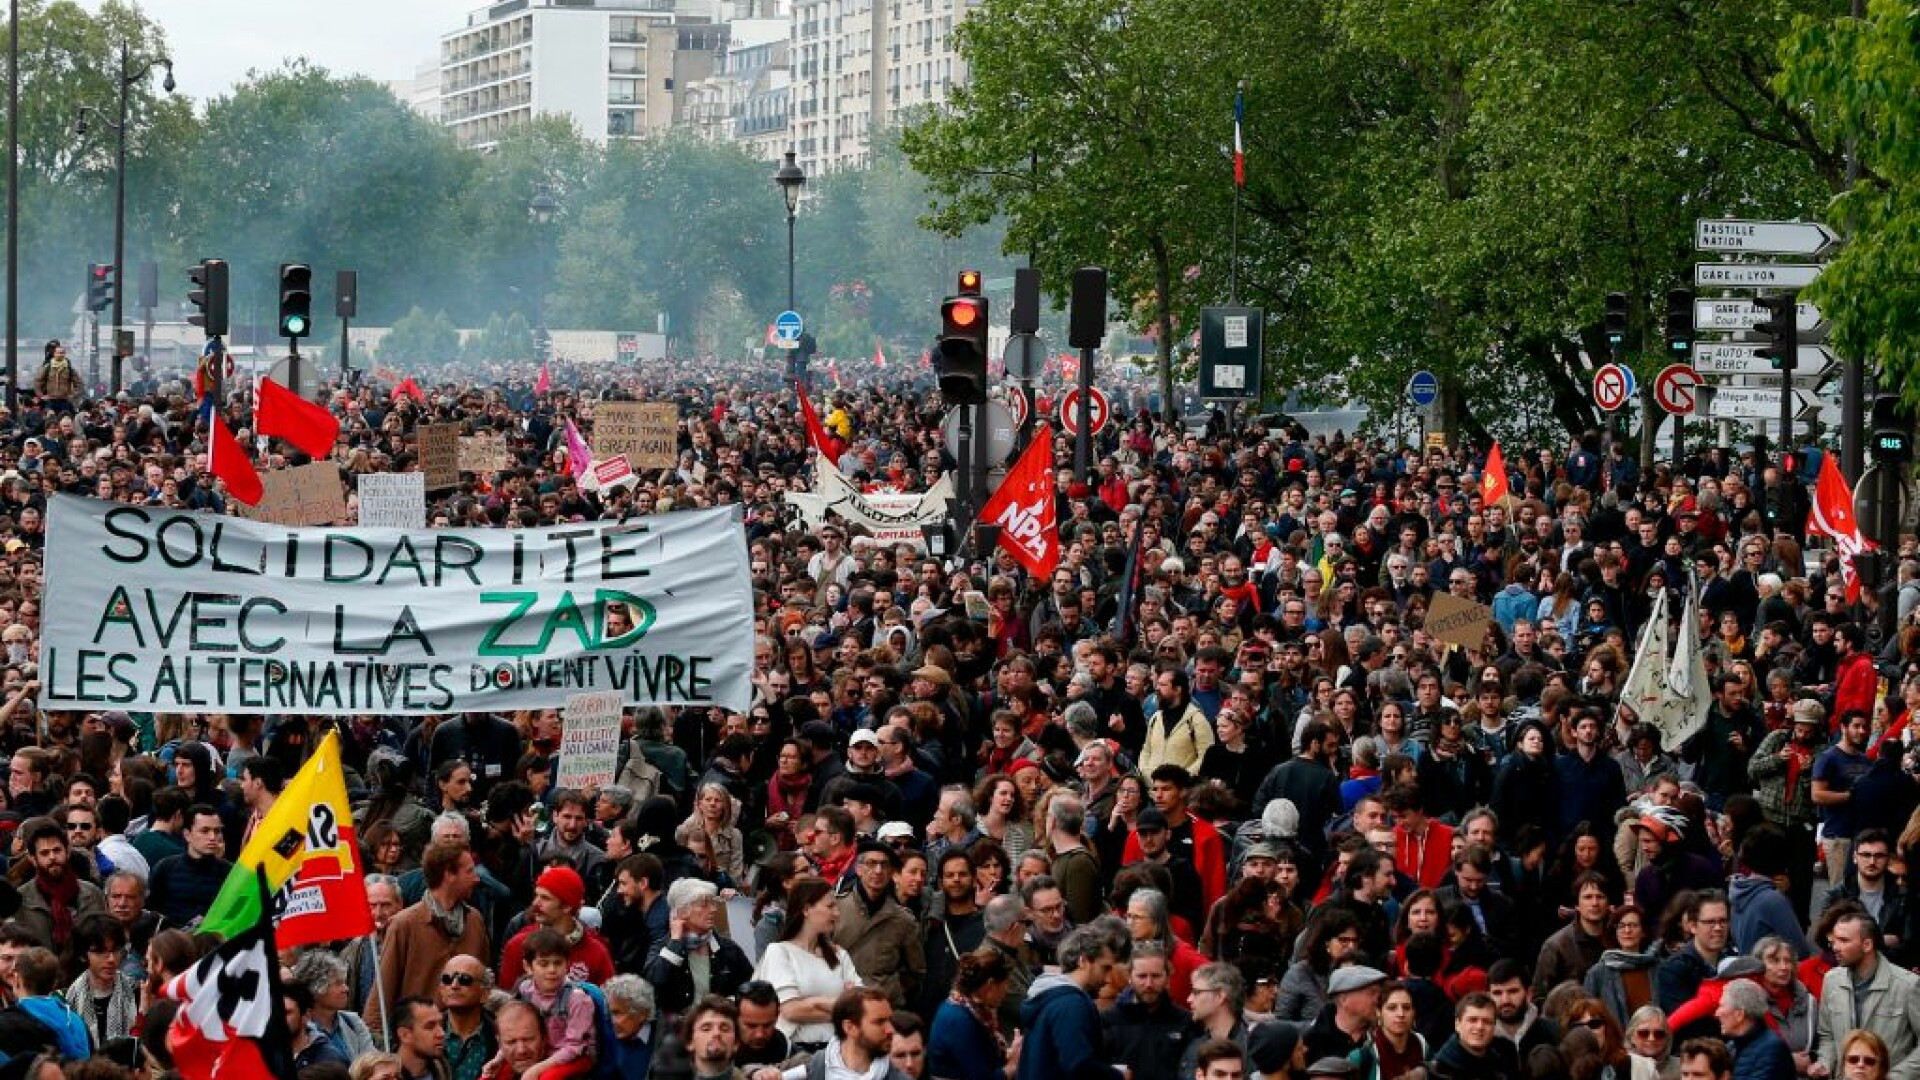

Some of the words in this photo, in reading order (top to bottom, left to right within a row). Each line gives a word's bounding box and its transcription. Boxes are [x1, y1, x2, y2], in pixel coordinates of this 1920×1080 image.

[1703, 224, 1755, 236] BASTILLE
[1703, 237, 1743, 246] NATION
[1702, 270, 1731, 280] GARE
[1747, 270, 1775, 280] LYON
[1715, 304, 1740, 313] GARE
[1715, 316, 1738, 325] Cour
[1715, 360, 1748, 370] BERCY
[607, 411, 636, 423] MAKE
[641, 411, 661, 423] OUR
[598, 425, 625, 435] CODE
[628, 425, 640, 435] DU
[599, 438, 637, 454] GREAT
[640, 439, 672, 454] AGAIN
[1880, 437, 1902, 449] BUS
[997, 501, 1047, 559] NPA
[93, 585, 288, 654] AVEC
[333, 604, 436, 656] LA
[478, 588, 657, 656] ZAD
[48, 647, 138, 703] LES
[149, 655, 454, 711] ALTERNATIVES
[470, 655, 599, 692] DOIVENT
[604, 650, 713, 702] VIVRE
